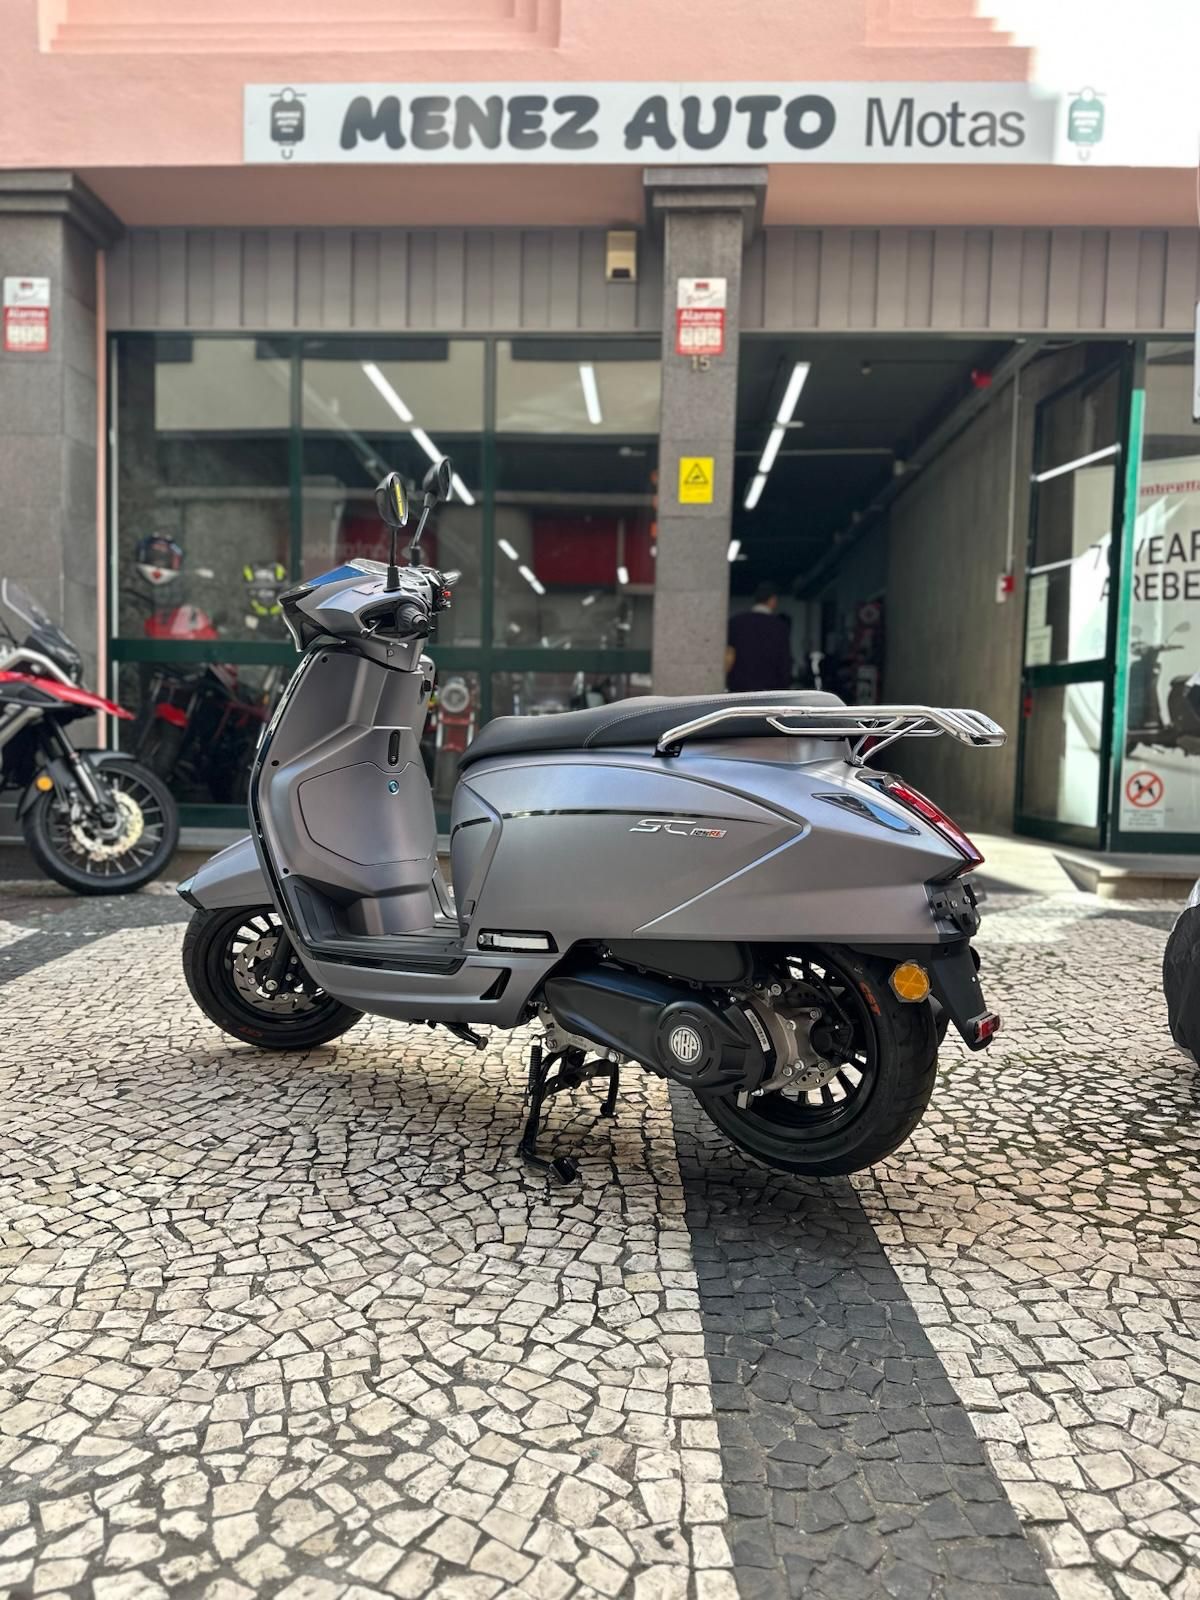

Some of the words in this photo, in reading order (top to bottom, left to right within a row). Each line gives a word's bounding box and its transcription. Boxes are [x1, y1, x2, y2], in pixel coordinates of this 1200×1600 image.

[339, 95, 600, 151] MENEZ
[624, 95, 837, 151] AUTO
[864, 97, 1026, 148] Motas
[681, 309, 722, 321] Alarme
[692, 355, 710, 371] 15
